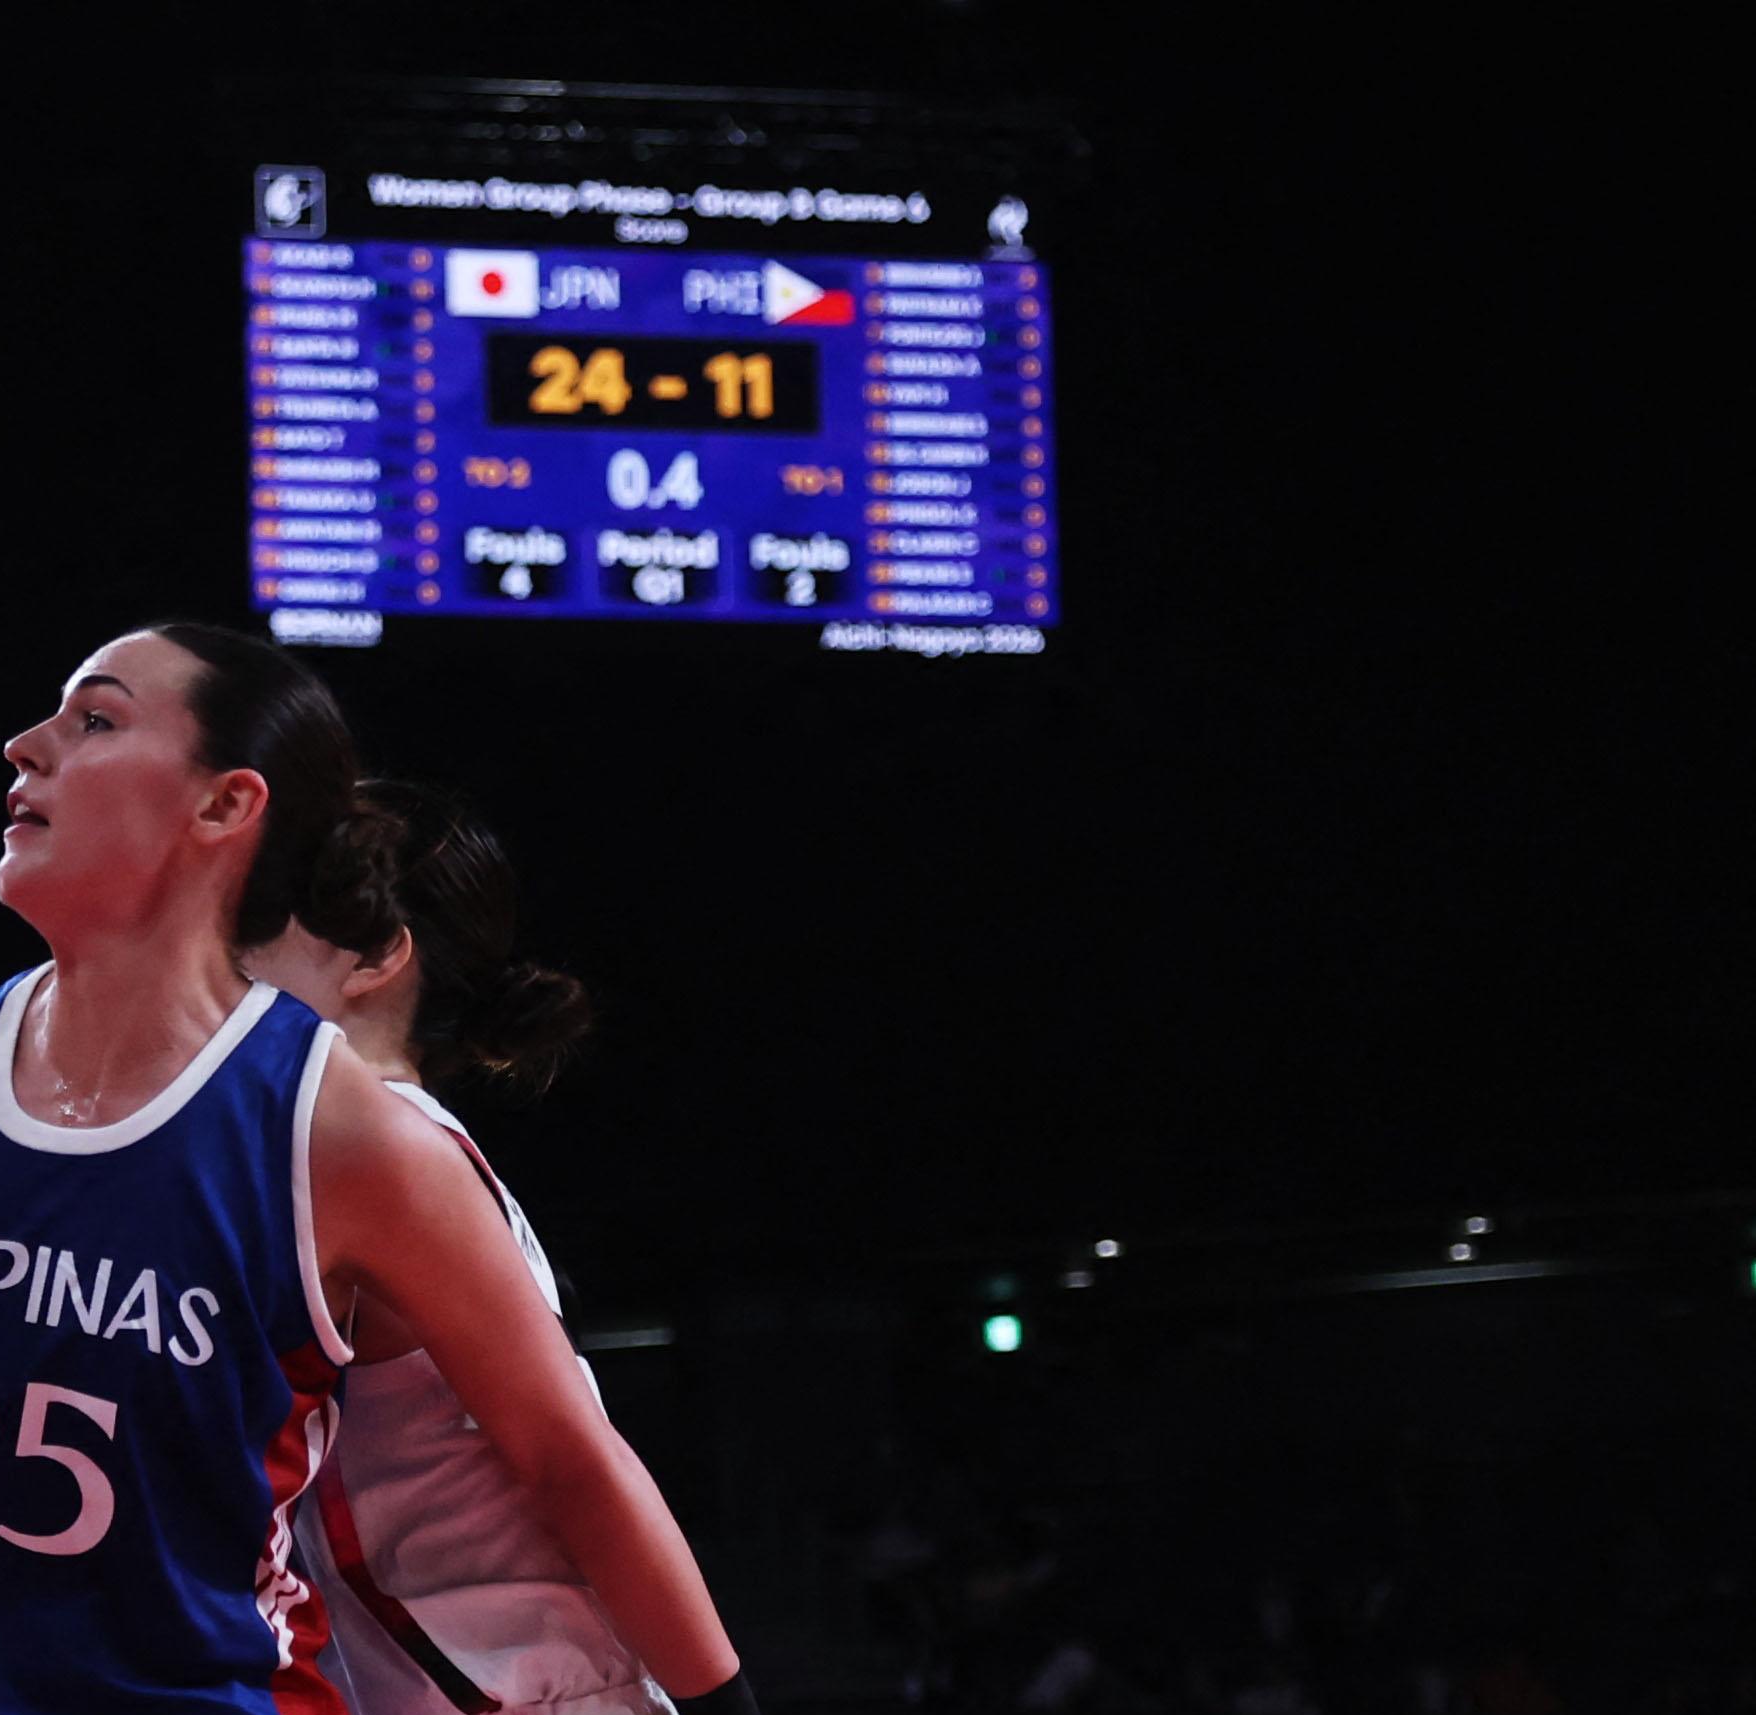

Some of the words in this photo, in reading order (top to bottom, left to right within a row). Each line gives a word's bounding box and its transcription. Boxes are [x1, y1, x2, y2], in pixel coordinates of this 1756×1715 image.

[540, 265, 620, 309] JPN
[684, 268, 763, 315] PHI
[529, 346, 631, 415] 24
[704, 352, 774, 418] 11
[606, 448, 704, 511] 0.4
[464, 526, 566, 565] Fouls
[597, 528, 719, 569] Period
[749, 531, 850, 572] Fouls
